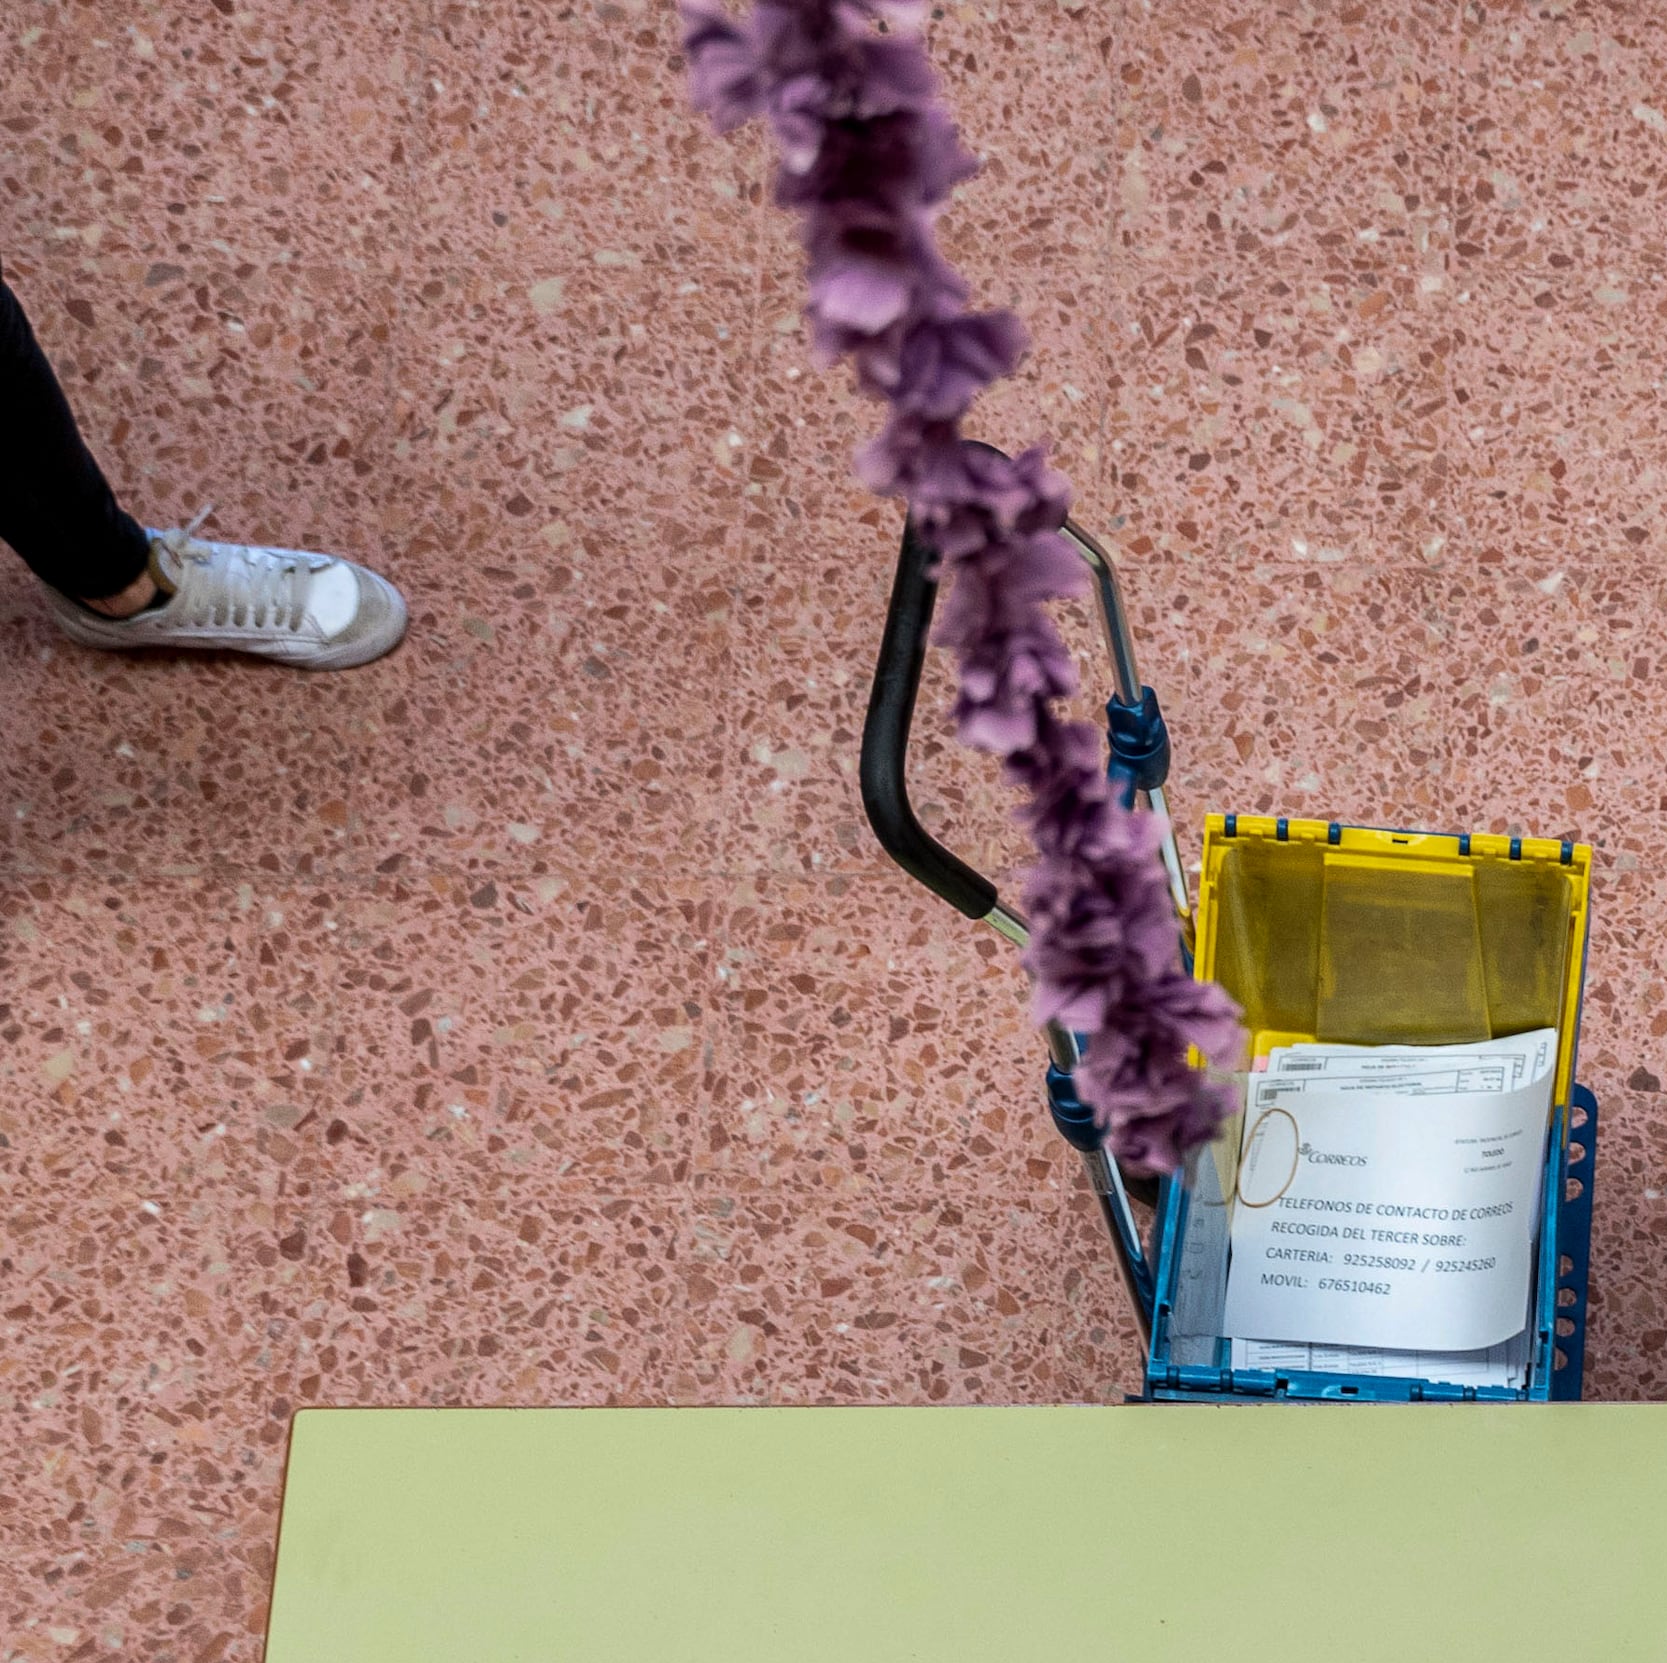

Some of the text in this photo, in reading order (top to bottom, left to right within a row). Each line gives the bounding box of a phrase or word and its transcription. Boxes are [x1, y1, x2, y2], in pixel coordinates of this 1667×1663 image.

[1278, 1196, 1513, 1221] TELEFONOS DE CONTACTO DE CORREOS
[1271, 1221, 1467, 1247] RECOGIDA DEL TERCER SOBRE:
[1265, 1247, 1334, 1264] CARTERIA:
[1343, 1253, 1416, 1271] 925258092
[1260, 1273, 1391, 1295] MOVIL: 676510462
